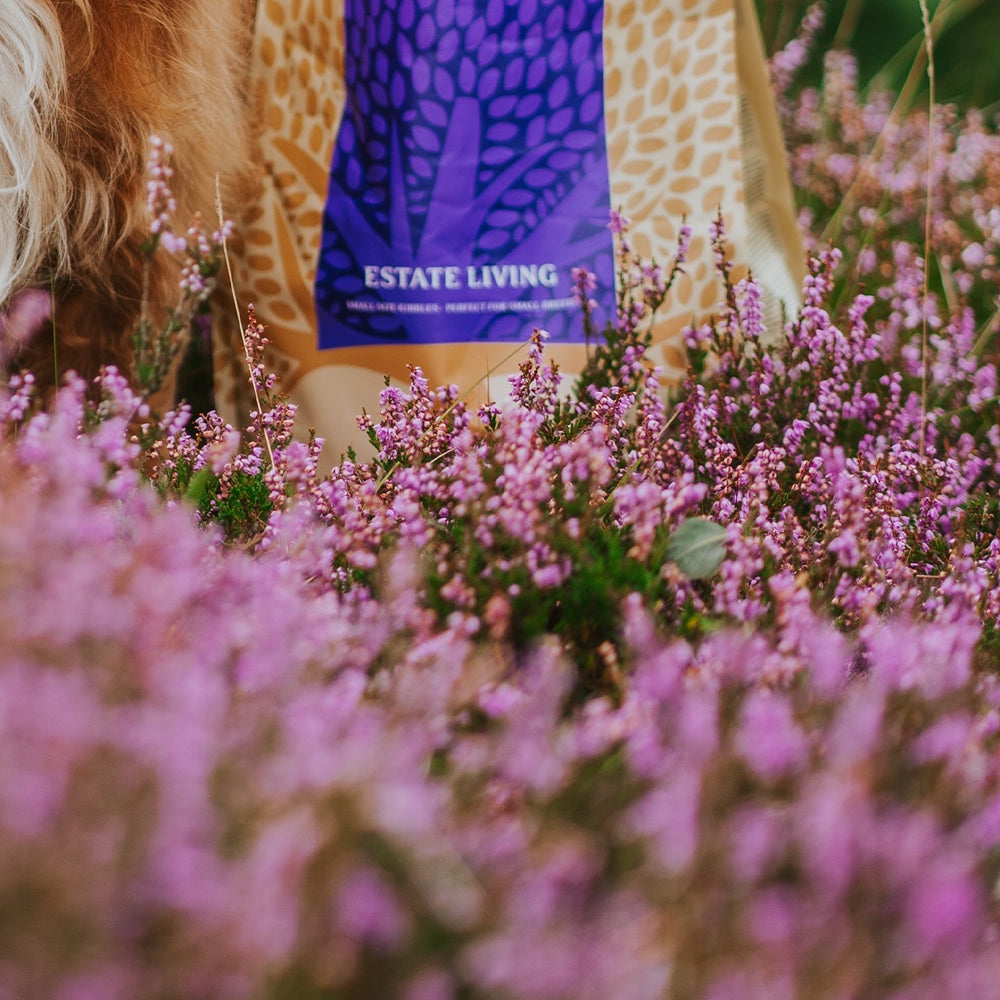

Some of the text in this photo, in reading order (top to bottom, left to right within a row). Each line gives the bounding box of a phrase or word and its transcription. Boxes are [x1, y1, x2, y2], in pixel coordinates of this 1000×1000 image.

[364, 263, 558, 290] ESTATE LIVING
[445, 302, 484, 313] PERFECT
[487, 301, 507, 312] FOR
[510, 300, 540, 312] SMALL
